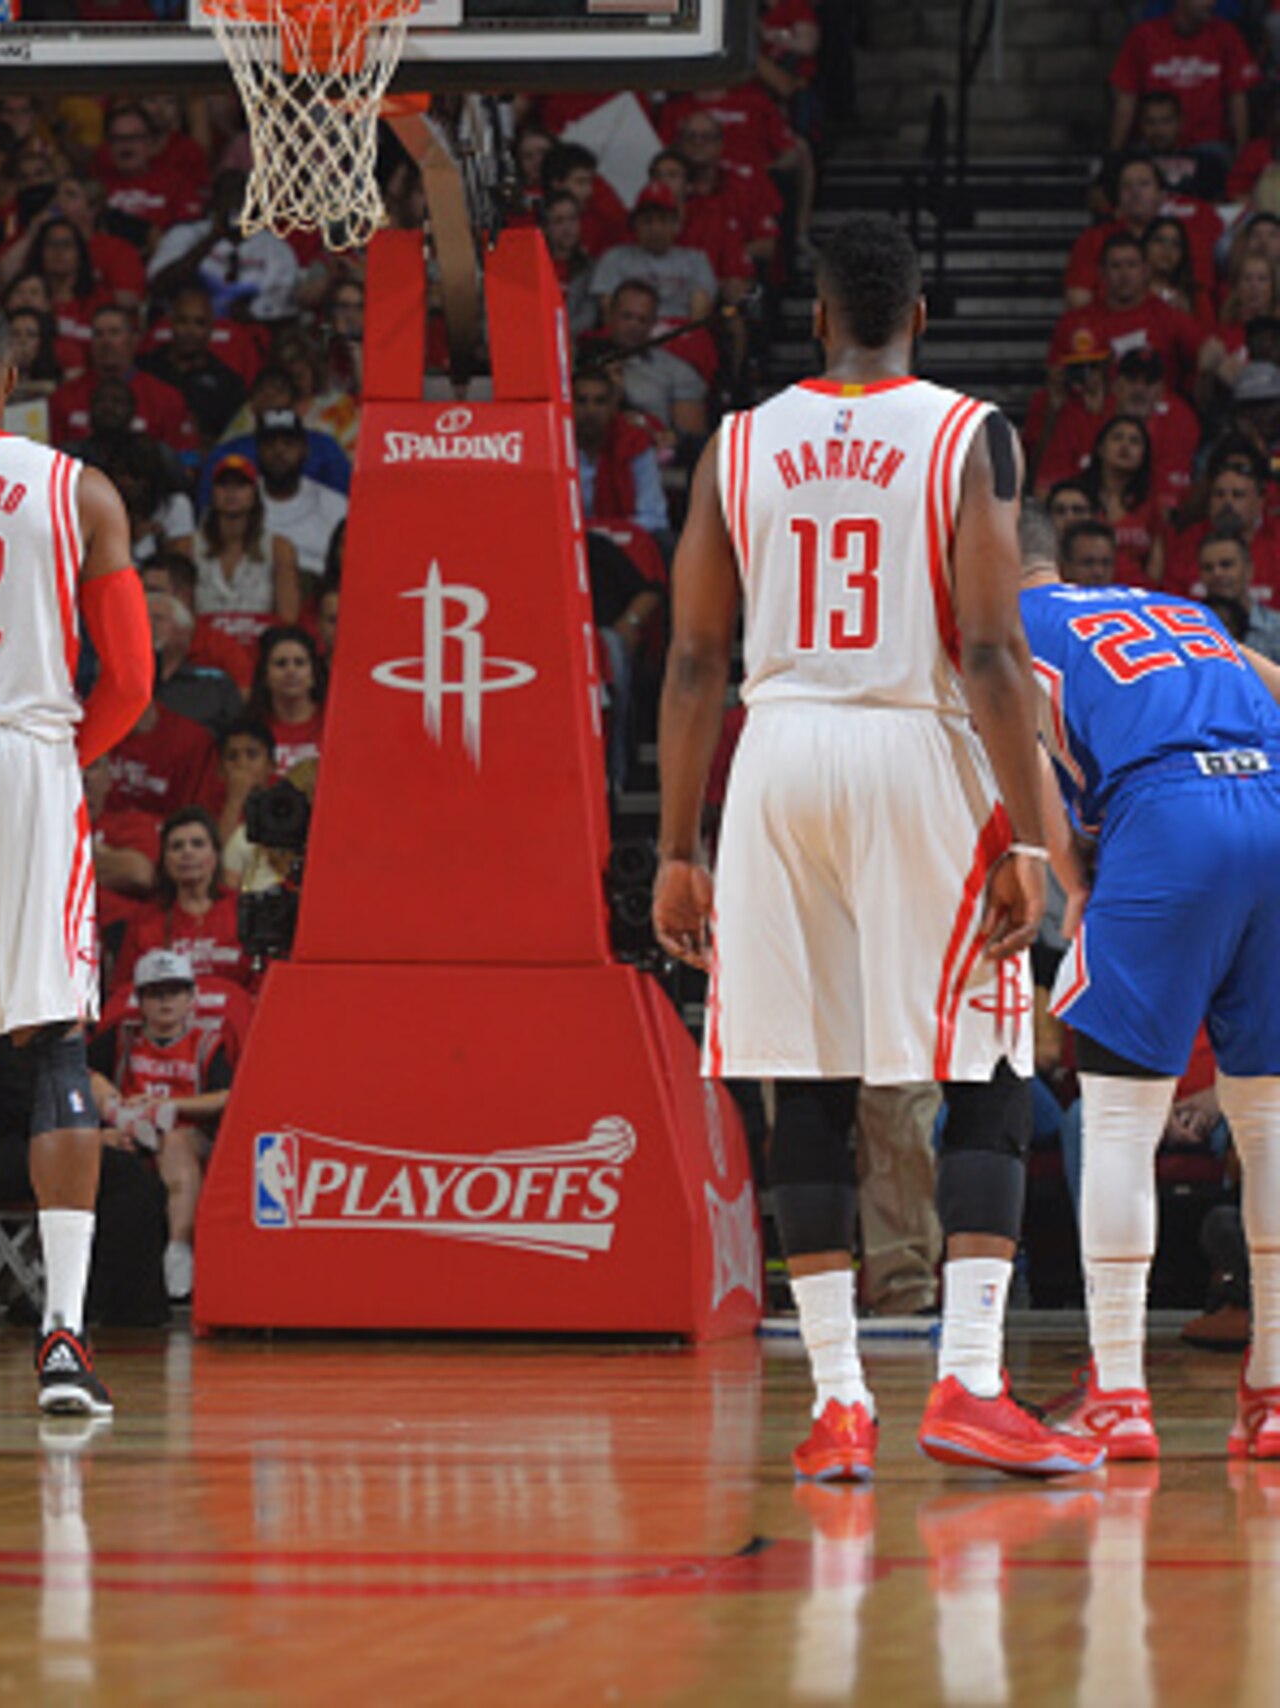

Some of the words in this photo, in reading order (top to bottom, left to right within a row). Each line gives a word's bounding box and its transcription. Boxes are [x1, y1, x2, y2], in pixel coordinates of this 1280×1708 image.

[383, 430, 523, 463] SPALDING
[773, 438, 907, 490] HARDEN
[788, 515, 881, 651] 13
[1069, 604, 1247, 685] 25
[297, 1159, 623, 1220] PLAYOFFS
